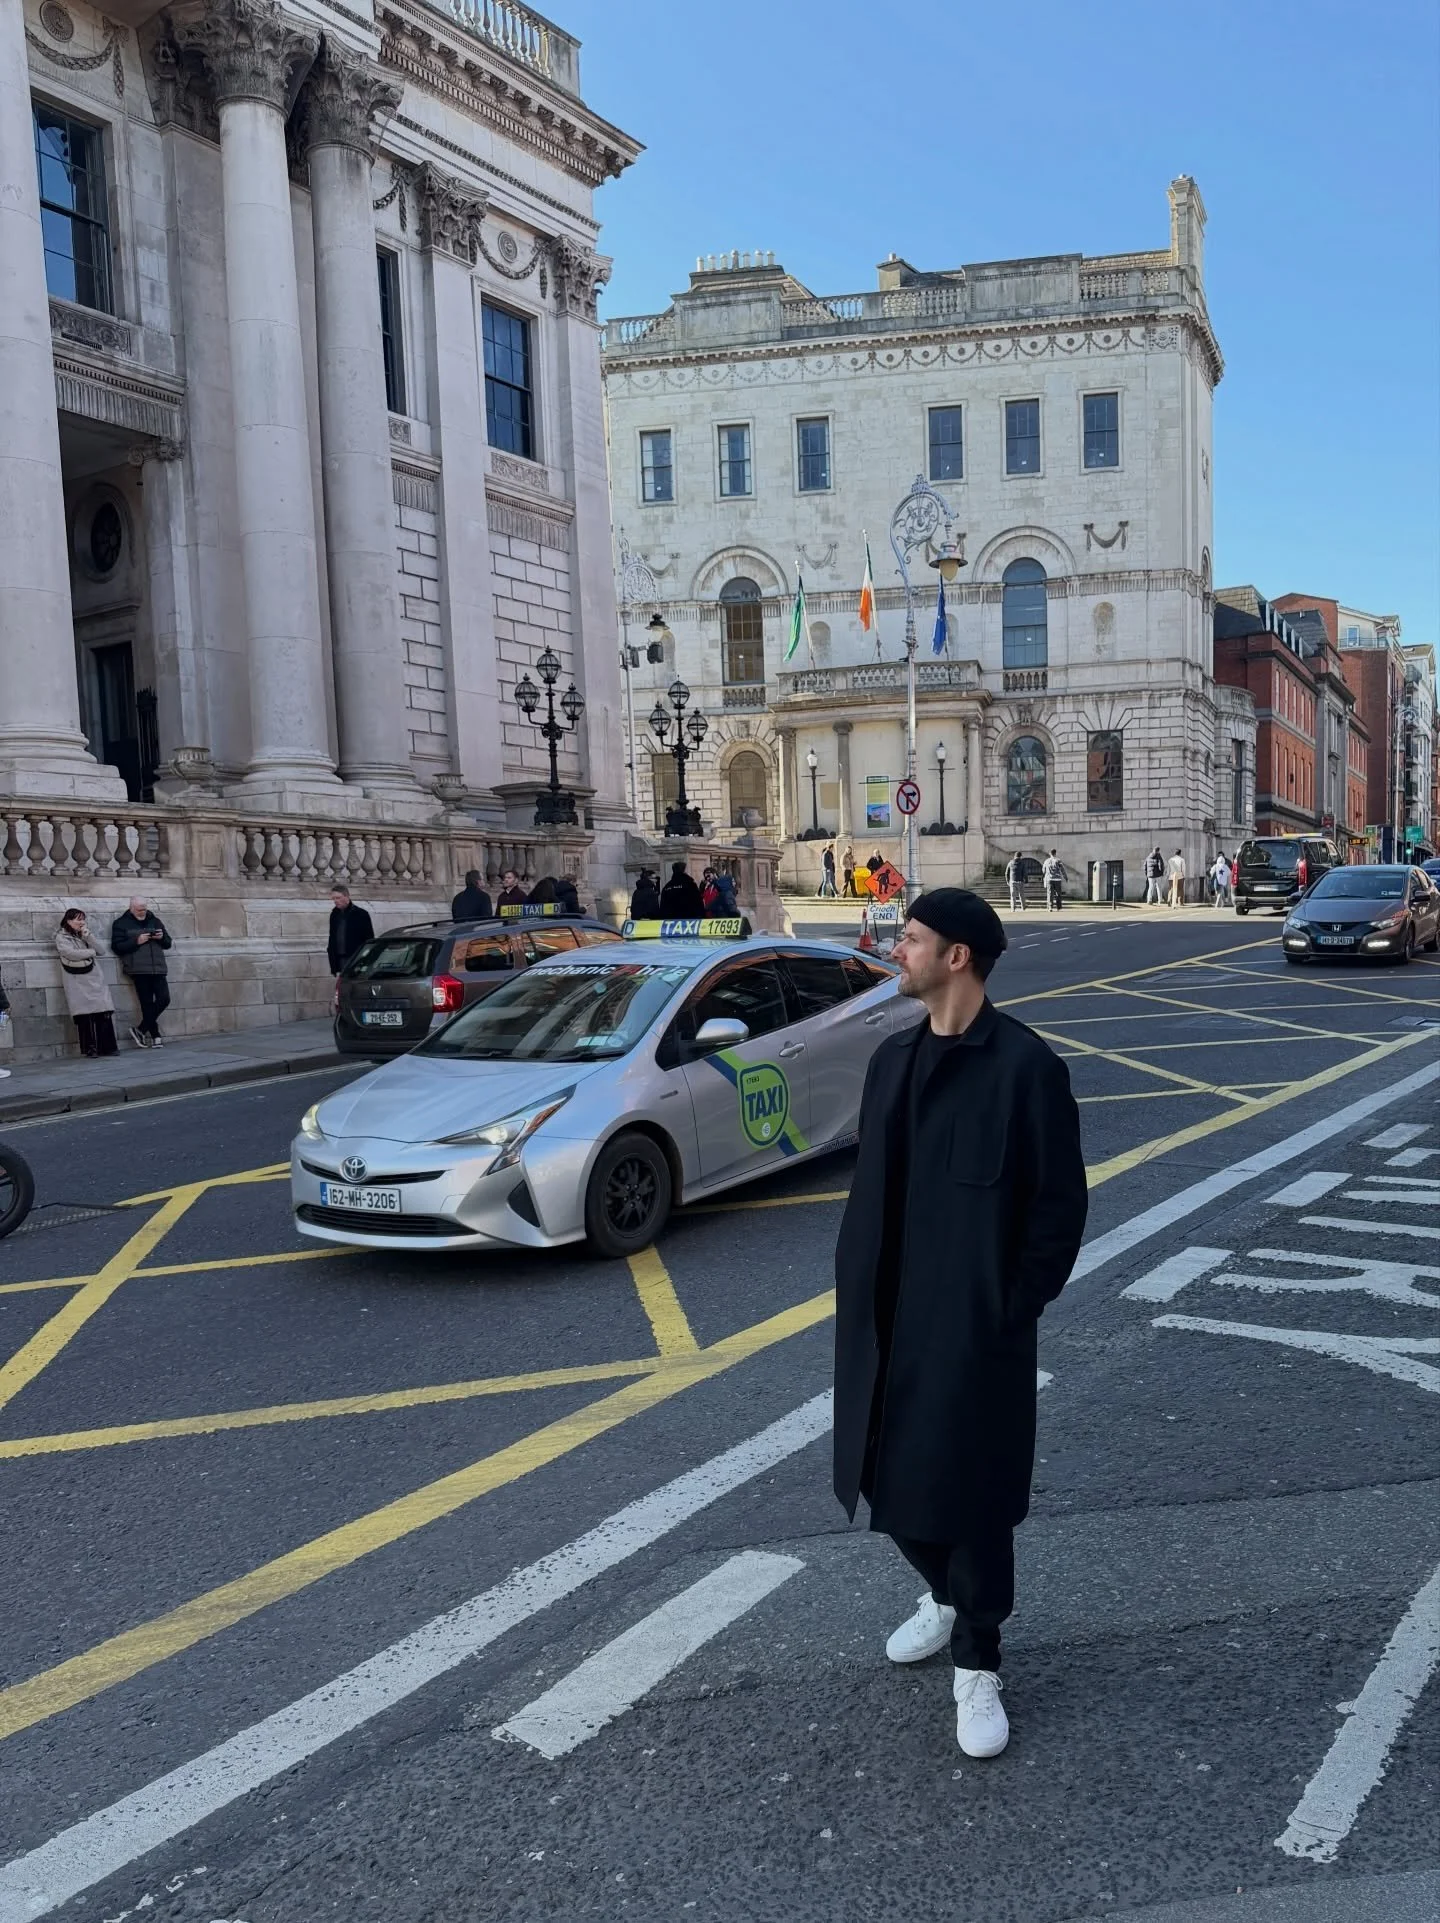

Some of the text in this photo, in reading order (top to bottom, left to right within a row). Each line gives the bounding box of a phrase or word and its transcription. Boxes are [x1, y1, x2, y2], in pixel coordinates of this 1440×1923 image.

[524, 904, 543, 915] TAXI
[872, 912, 893, 920] END
[624, 919, 740, 936] D TAXI 17693
[745, 1085, 783, 1122] TAXI
[328, 1188, 396, 1210] 162-MH-3206
